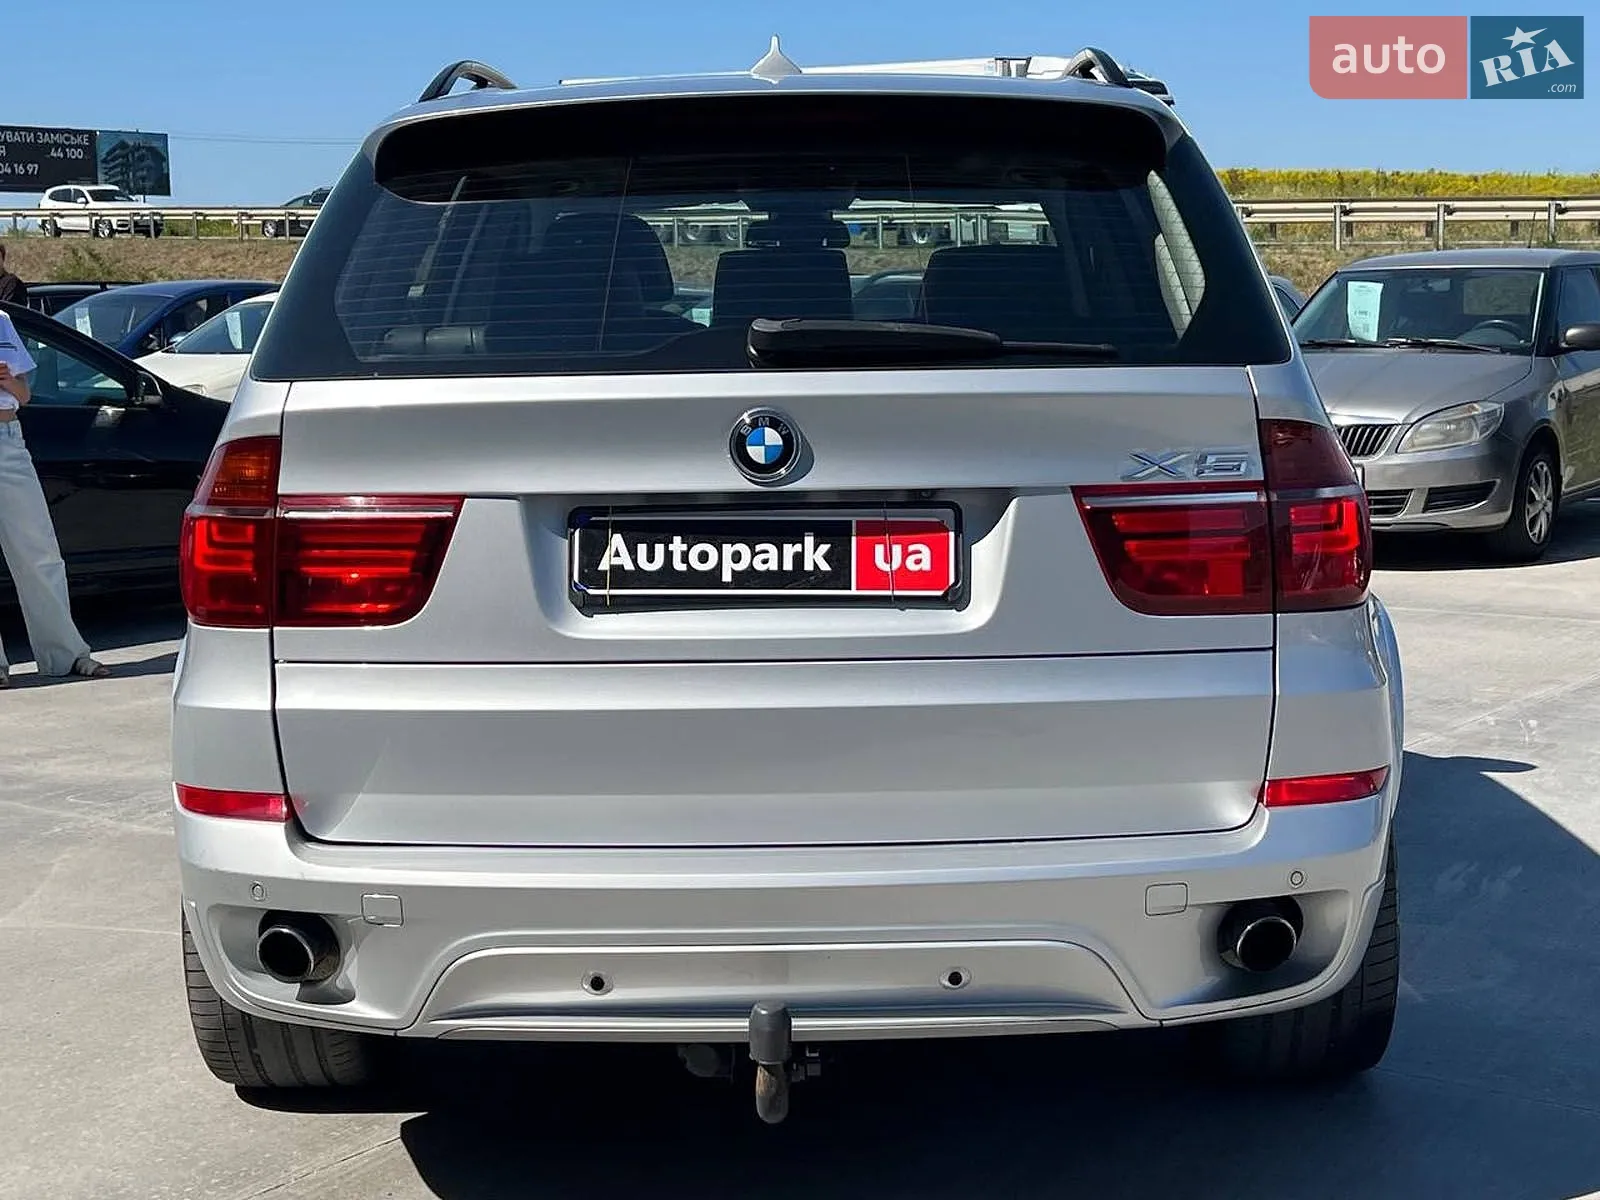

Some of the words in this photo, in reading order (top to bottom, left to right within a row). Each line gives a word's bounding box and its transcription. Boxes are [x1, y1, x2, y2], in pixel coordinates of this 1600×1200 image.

[36, 132, 89, 145] ЗАМІСЬКЕ
[65, 148, 83, 159] 100
[26, 163, 39, 175] 97
[1120, 450, 1250, 481] X5
[598, 533, 831, 582] Autopark
[874, 542, 931, 571] ua
